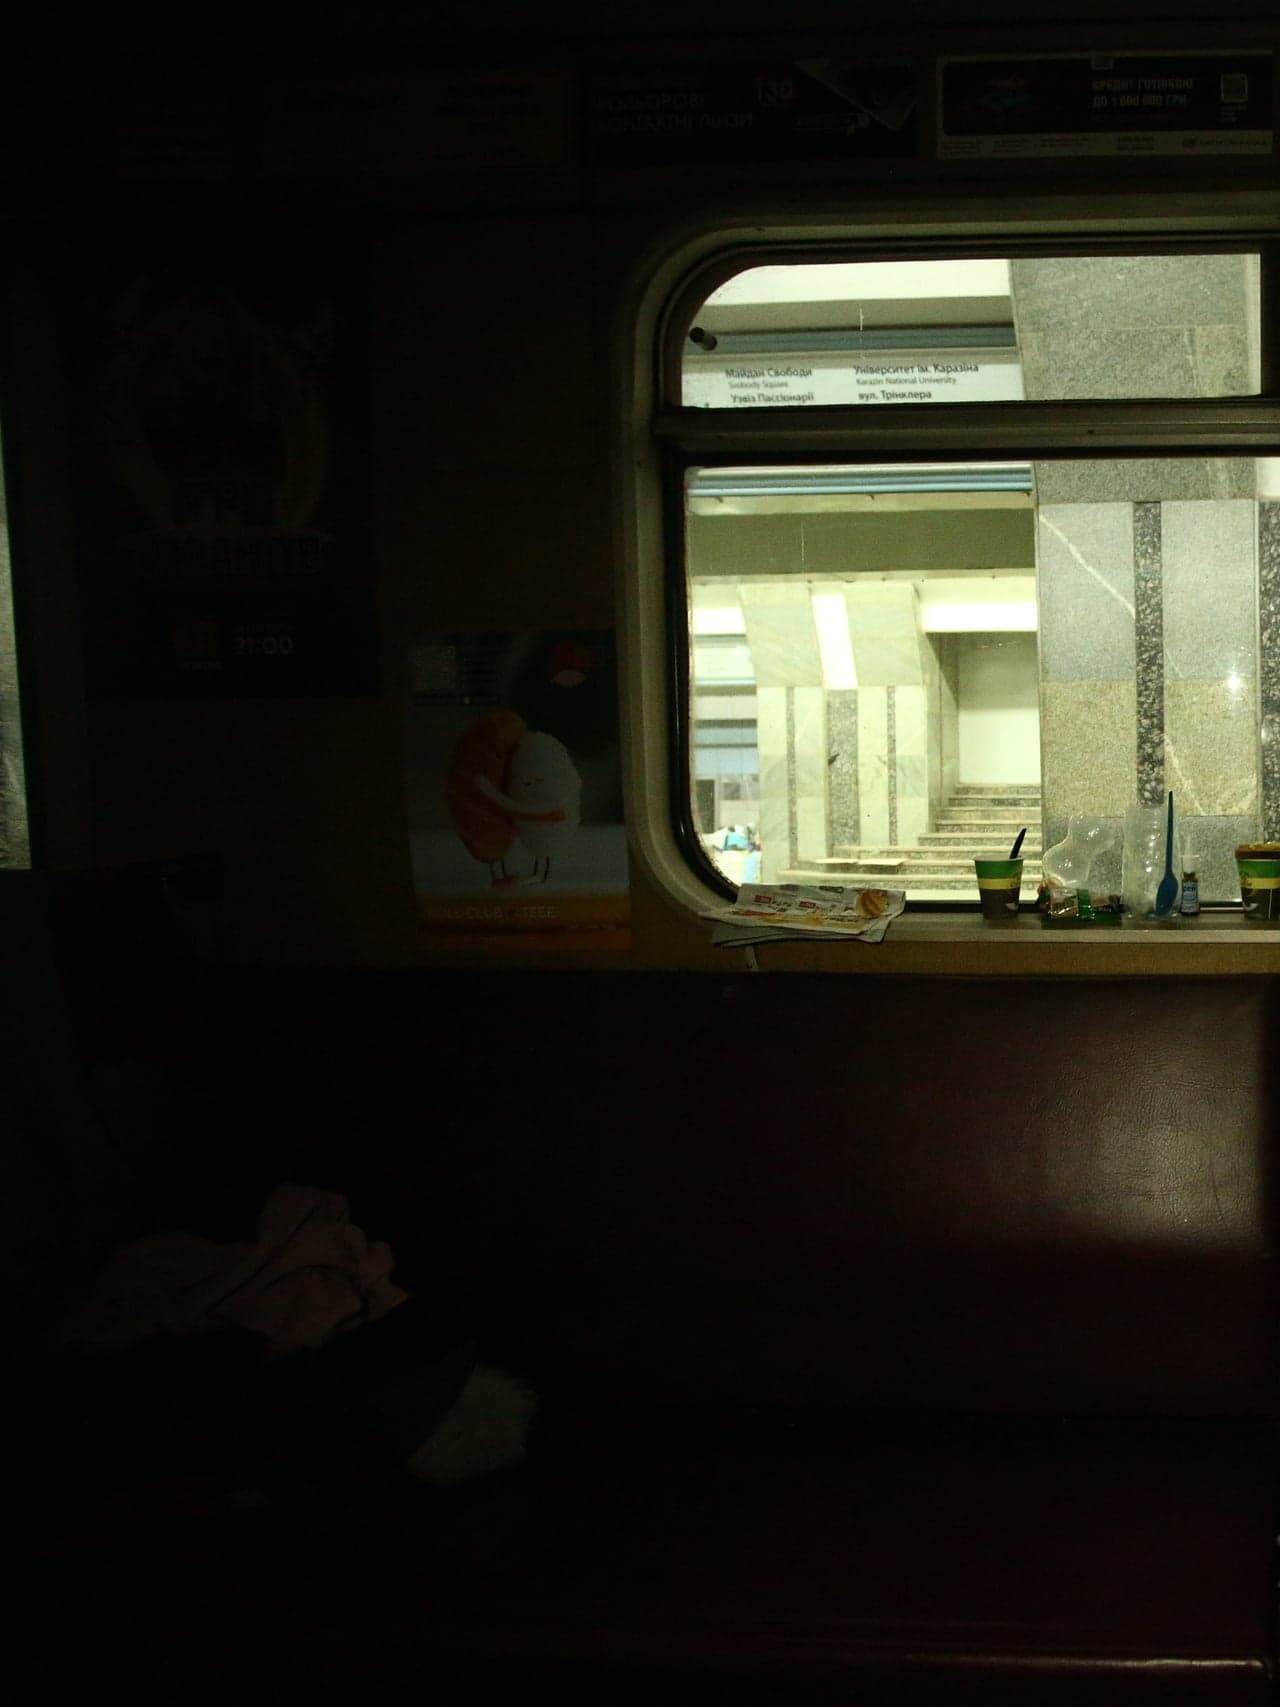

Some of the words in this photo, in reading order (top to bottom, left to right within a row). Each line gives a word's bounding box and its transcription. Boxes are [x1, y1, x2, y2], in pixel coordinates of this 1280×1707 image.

[767, 366, 813, 378] Свободи
[853, 365, 914, 377] Університет
[933, 363, 980, 375] Каразіна
[858, 392, 878, 402] вул.
[880, 390, 932, 402] Трінклера
